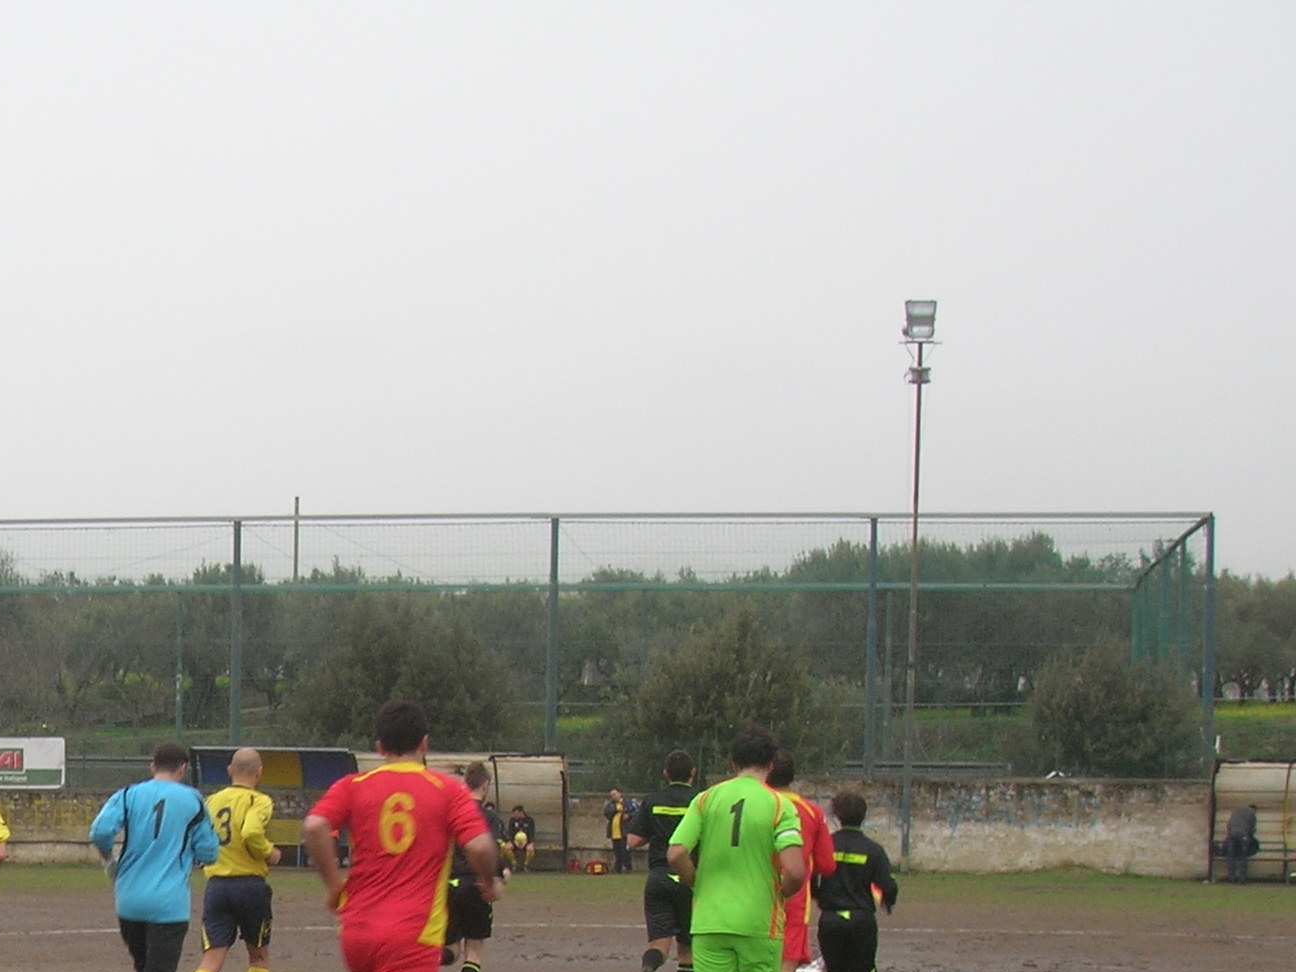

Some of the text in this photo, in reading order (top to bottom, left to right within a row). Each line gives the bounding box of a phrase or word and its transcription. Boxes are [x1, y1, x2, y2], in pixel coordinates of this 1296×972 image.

[152, 798, 166, 840] 1
[215, 807, 232, 847] 3
[378, 792, 417, 855] 6
[730, 798, 746, 848] 1
